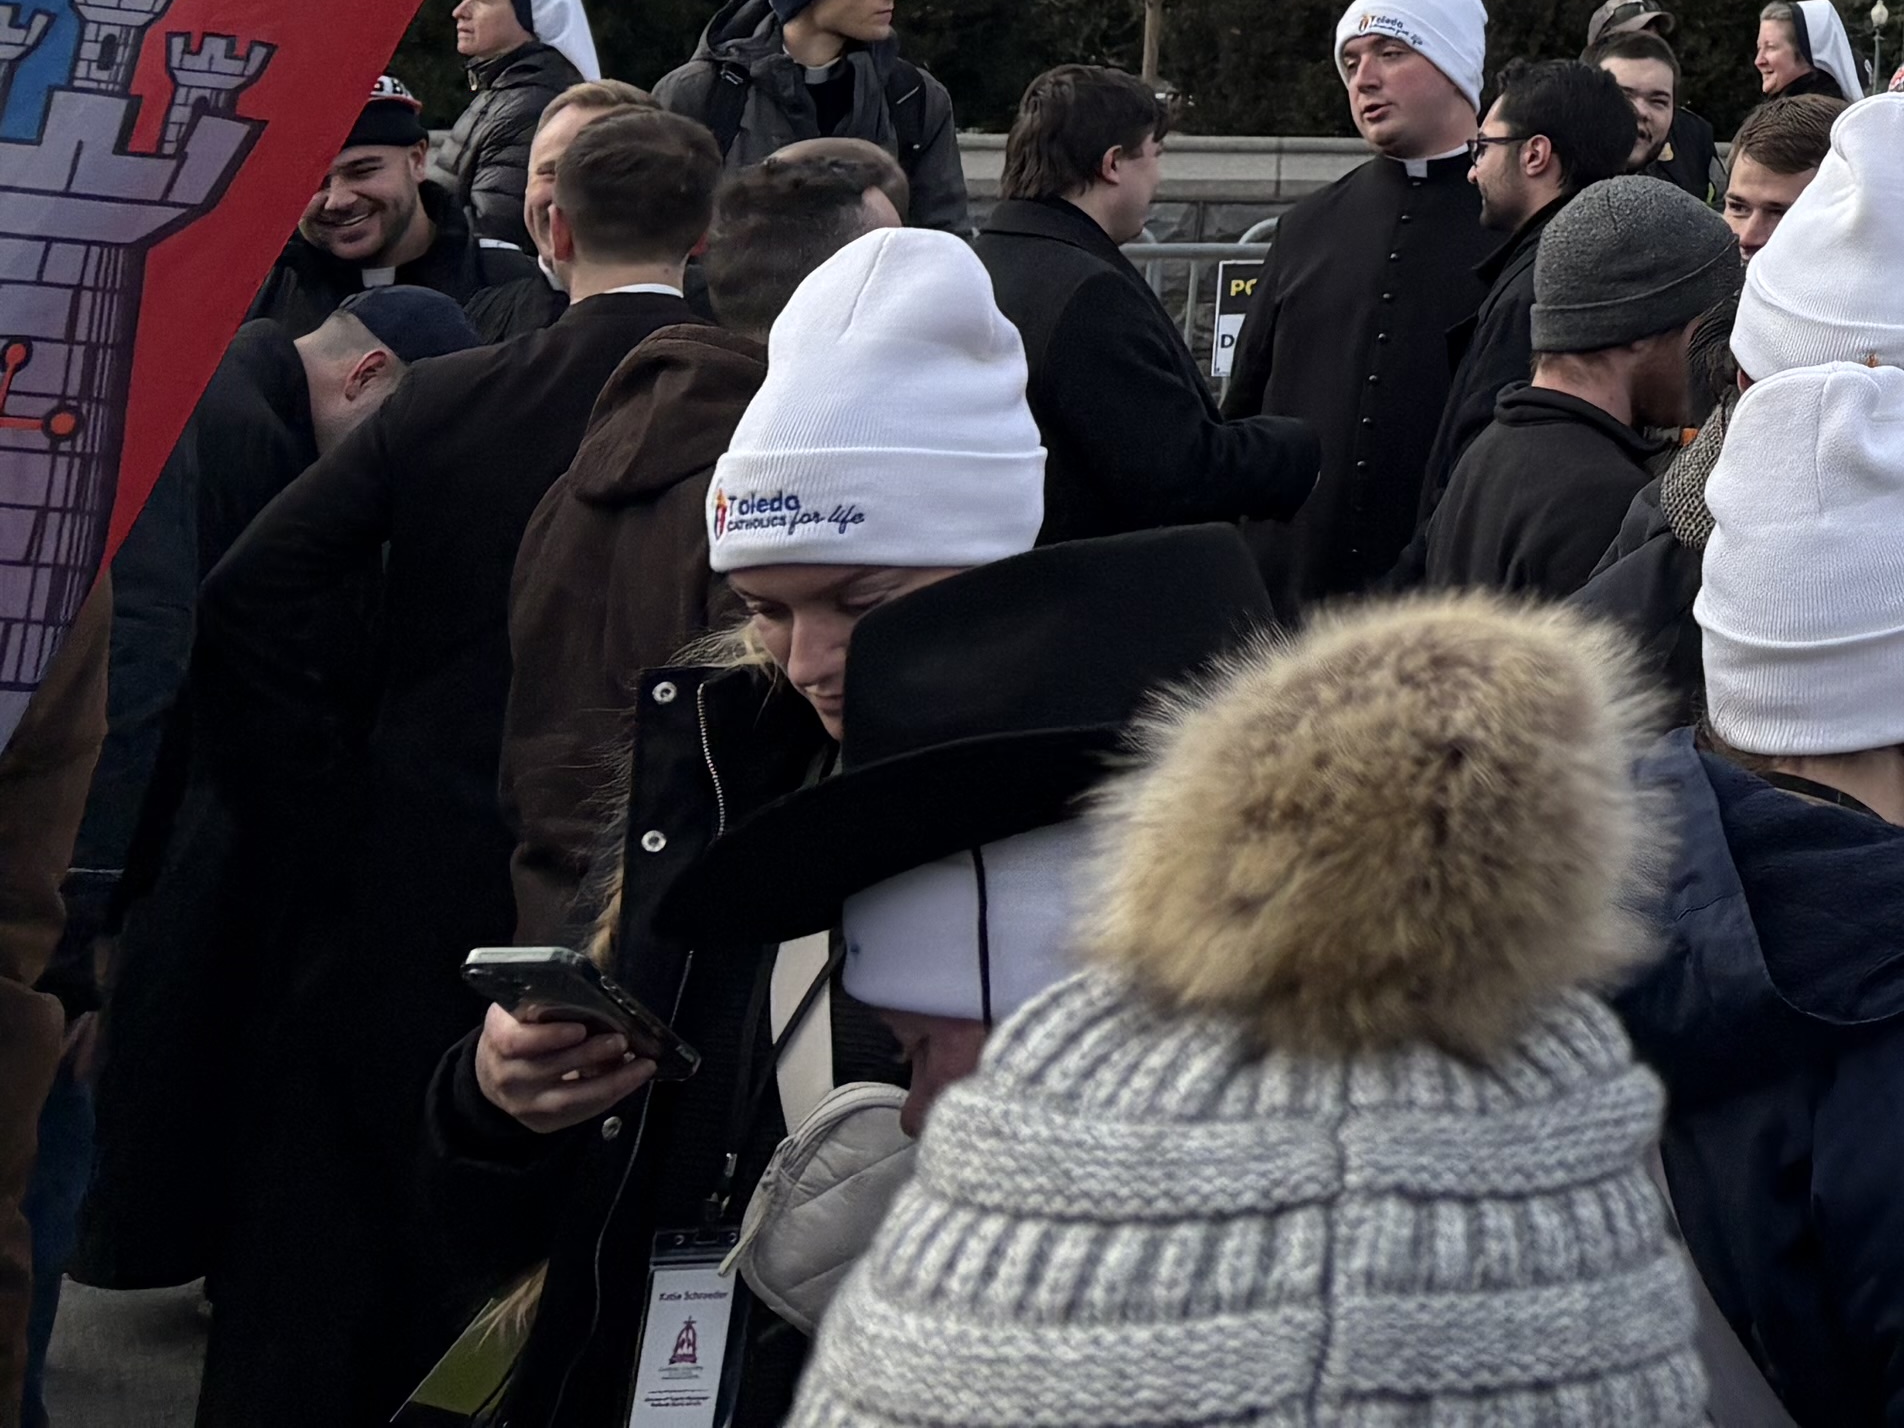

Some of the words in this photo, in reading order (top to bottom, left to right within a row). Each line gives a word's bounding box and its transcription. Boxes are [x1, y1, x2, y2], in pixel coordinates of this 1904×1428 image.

[728, 489, 801, 516] Toledo
[727, 515, 787, 532] CATHOLICS
[788, 508, 826, 535] for
[827, 504, 866, 534] life
